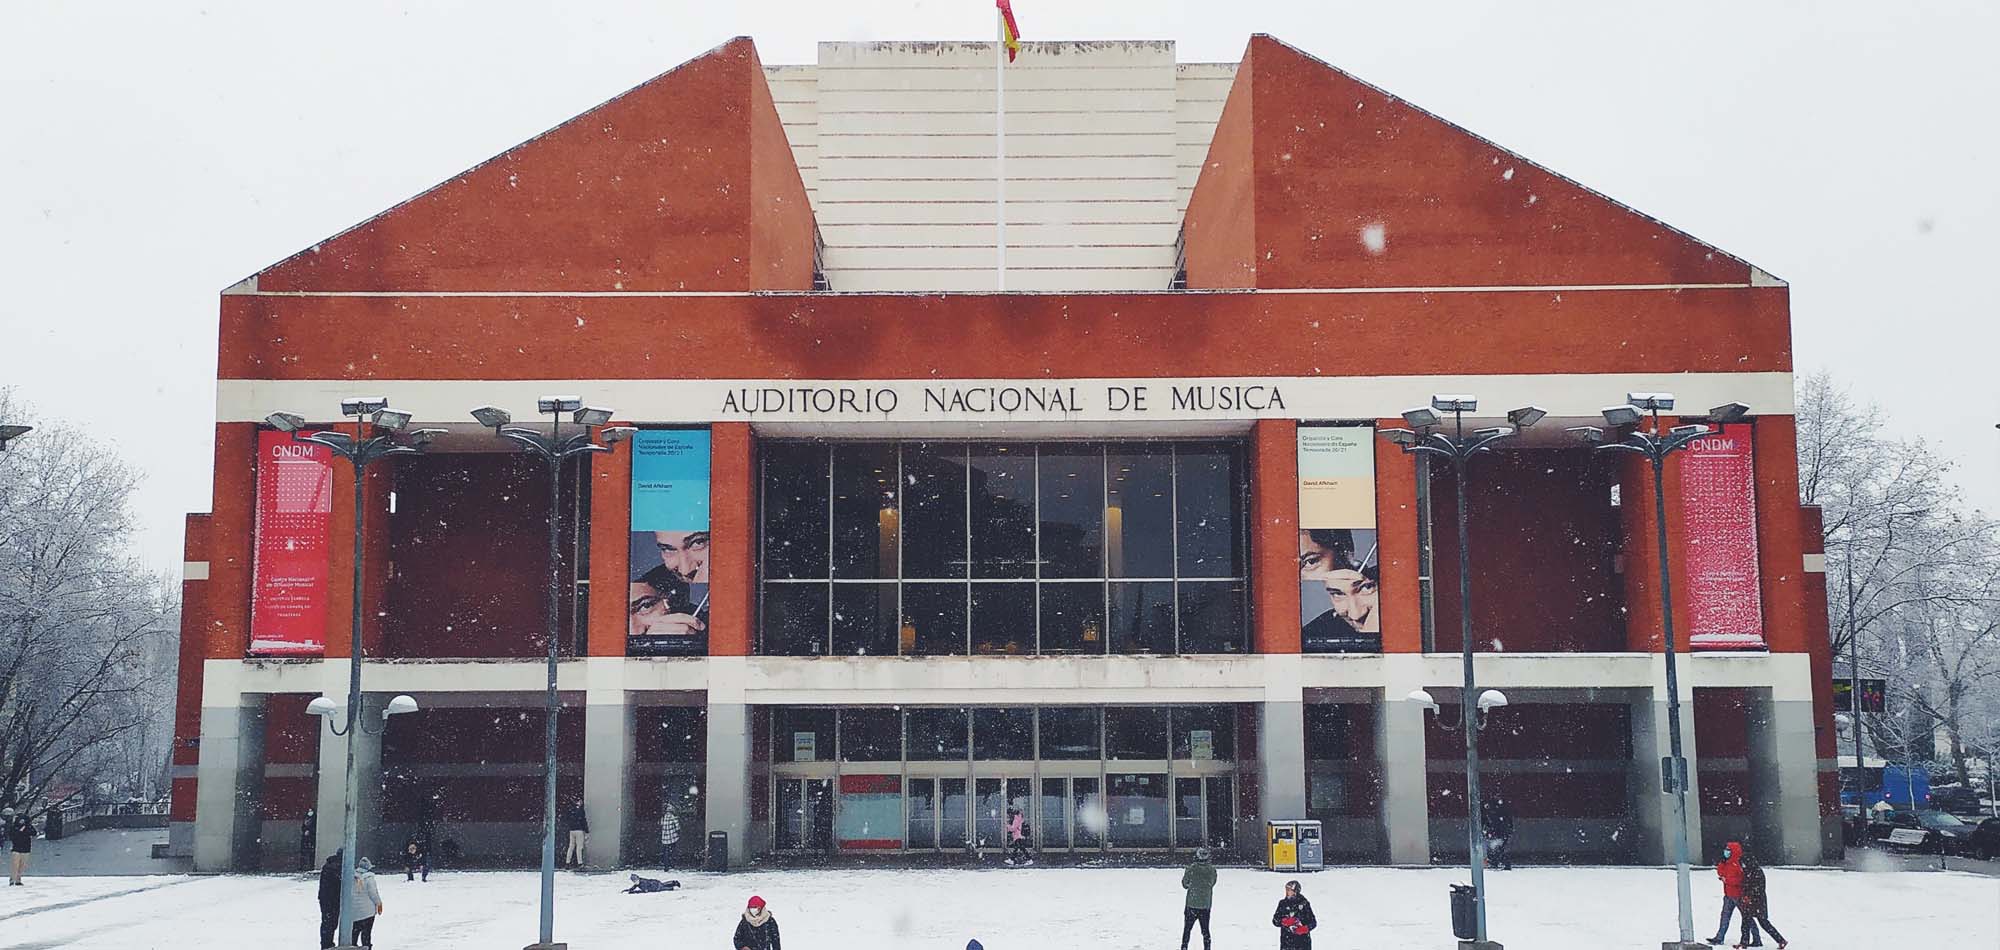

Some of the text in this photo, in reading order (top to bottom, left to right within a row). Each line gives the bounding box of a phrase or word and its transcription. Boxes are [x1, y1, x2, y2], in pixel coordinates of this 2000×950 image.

[722, 386, 1286, 413] AUDITORIO NACIONAL DE MUSICA
[272, 445, 314, 457] CNDM
[1692, 438, 1734, 451] CNDM
